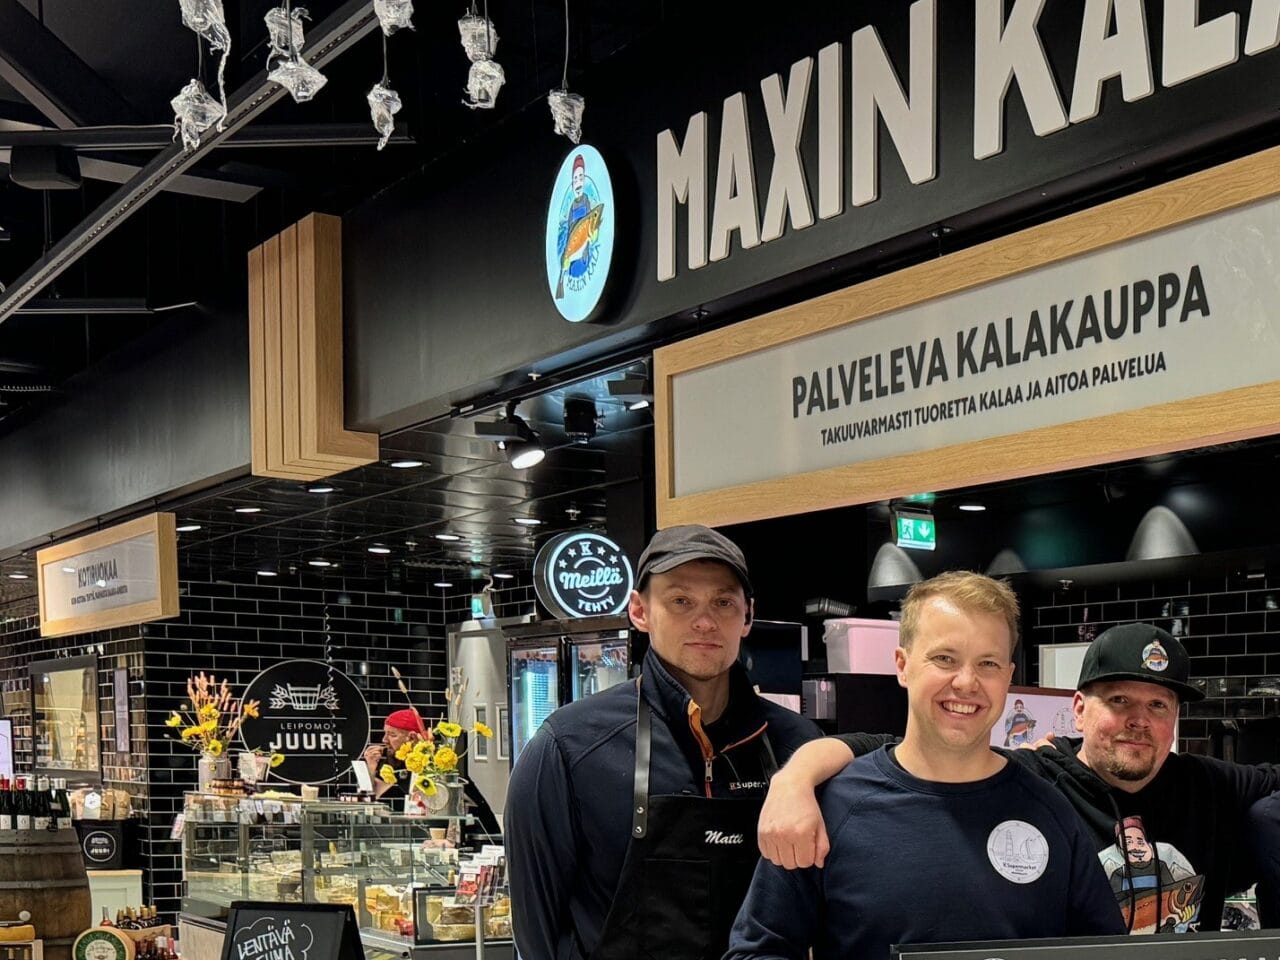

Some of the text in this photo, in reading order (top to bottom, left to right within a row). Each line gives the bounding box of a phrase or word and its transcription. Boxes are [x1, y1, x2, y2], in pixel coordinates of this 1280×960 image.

[657, 0, 937, 281] MAXIN
[792, 264, 1211, 419] PALVELEVA KALAKAUPPA
[820, 350, 1167, 447] TAKUUVARMASTI TUORETTA KALAA JA AITOA PALVELUA
[559, 566, 623, 589] Meillä
[578, 595, 615, 612] TEHTY
[269, 733, 342, 750] JUURI
[705, 830, 743, 844] Matti
[237, 919, 295, 960] LENTÄVÄ
